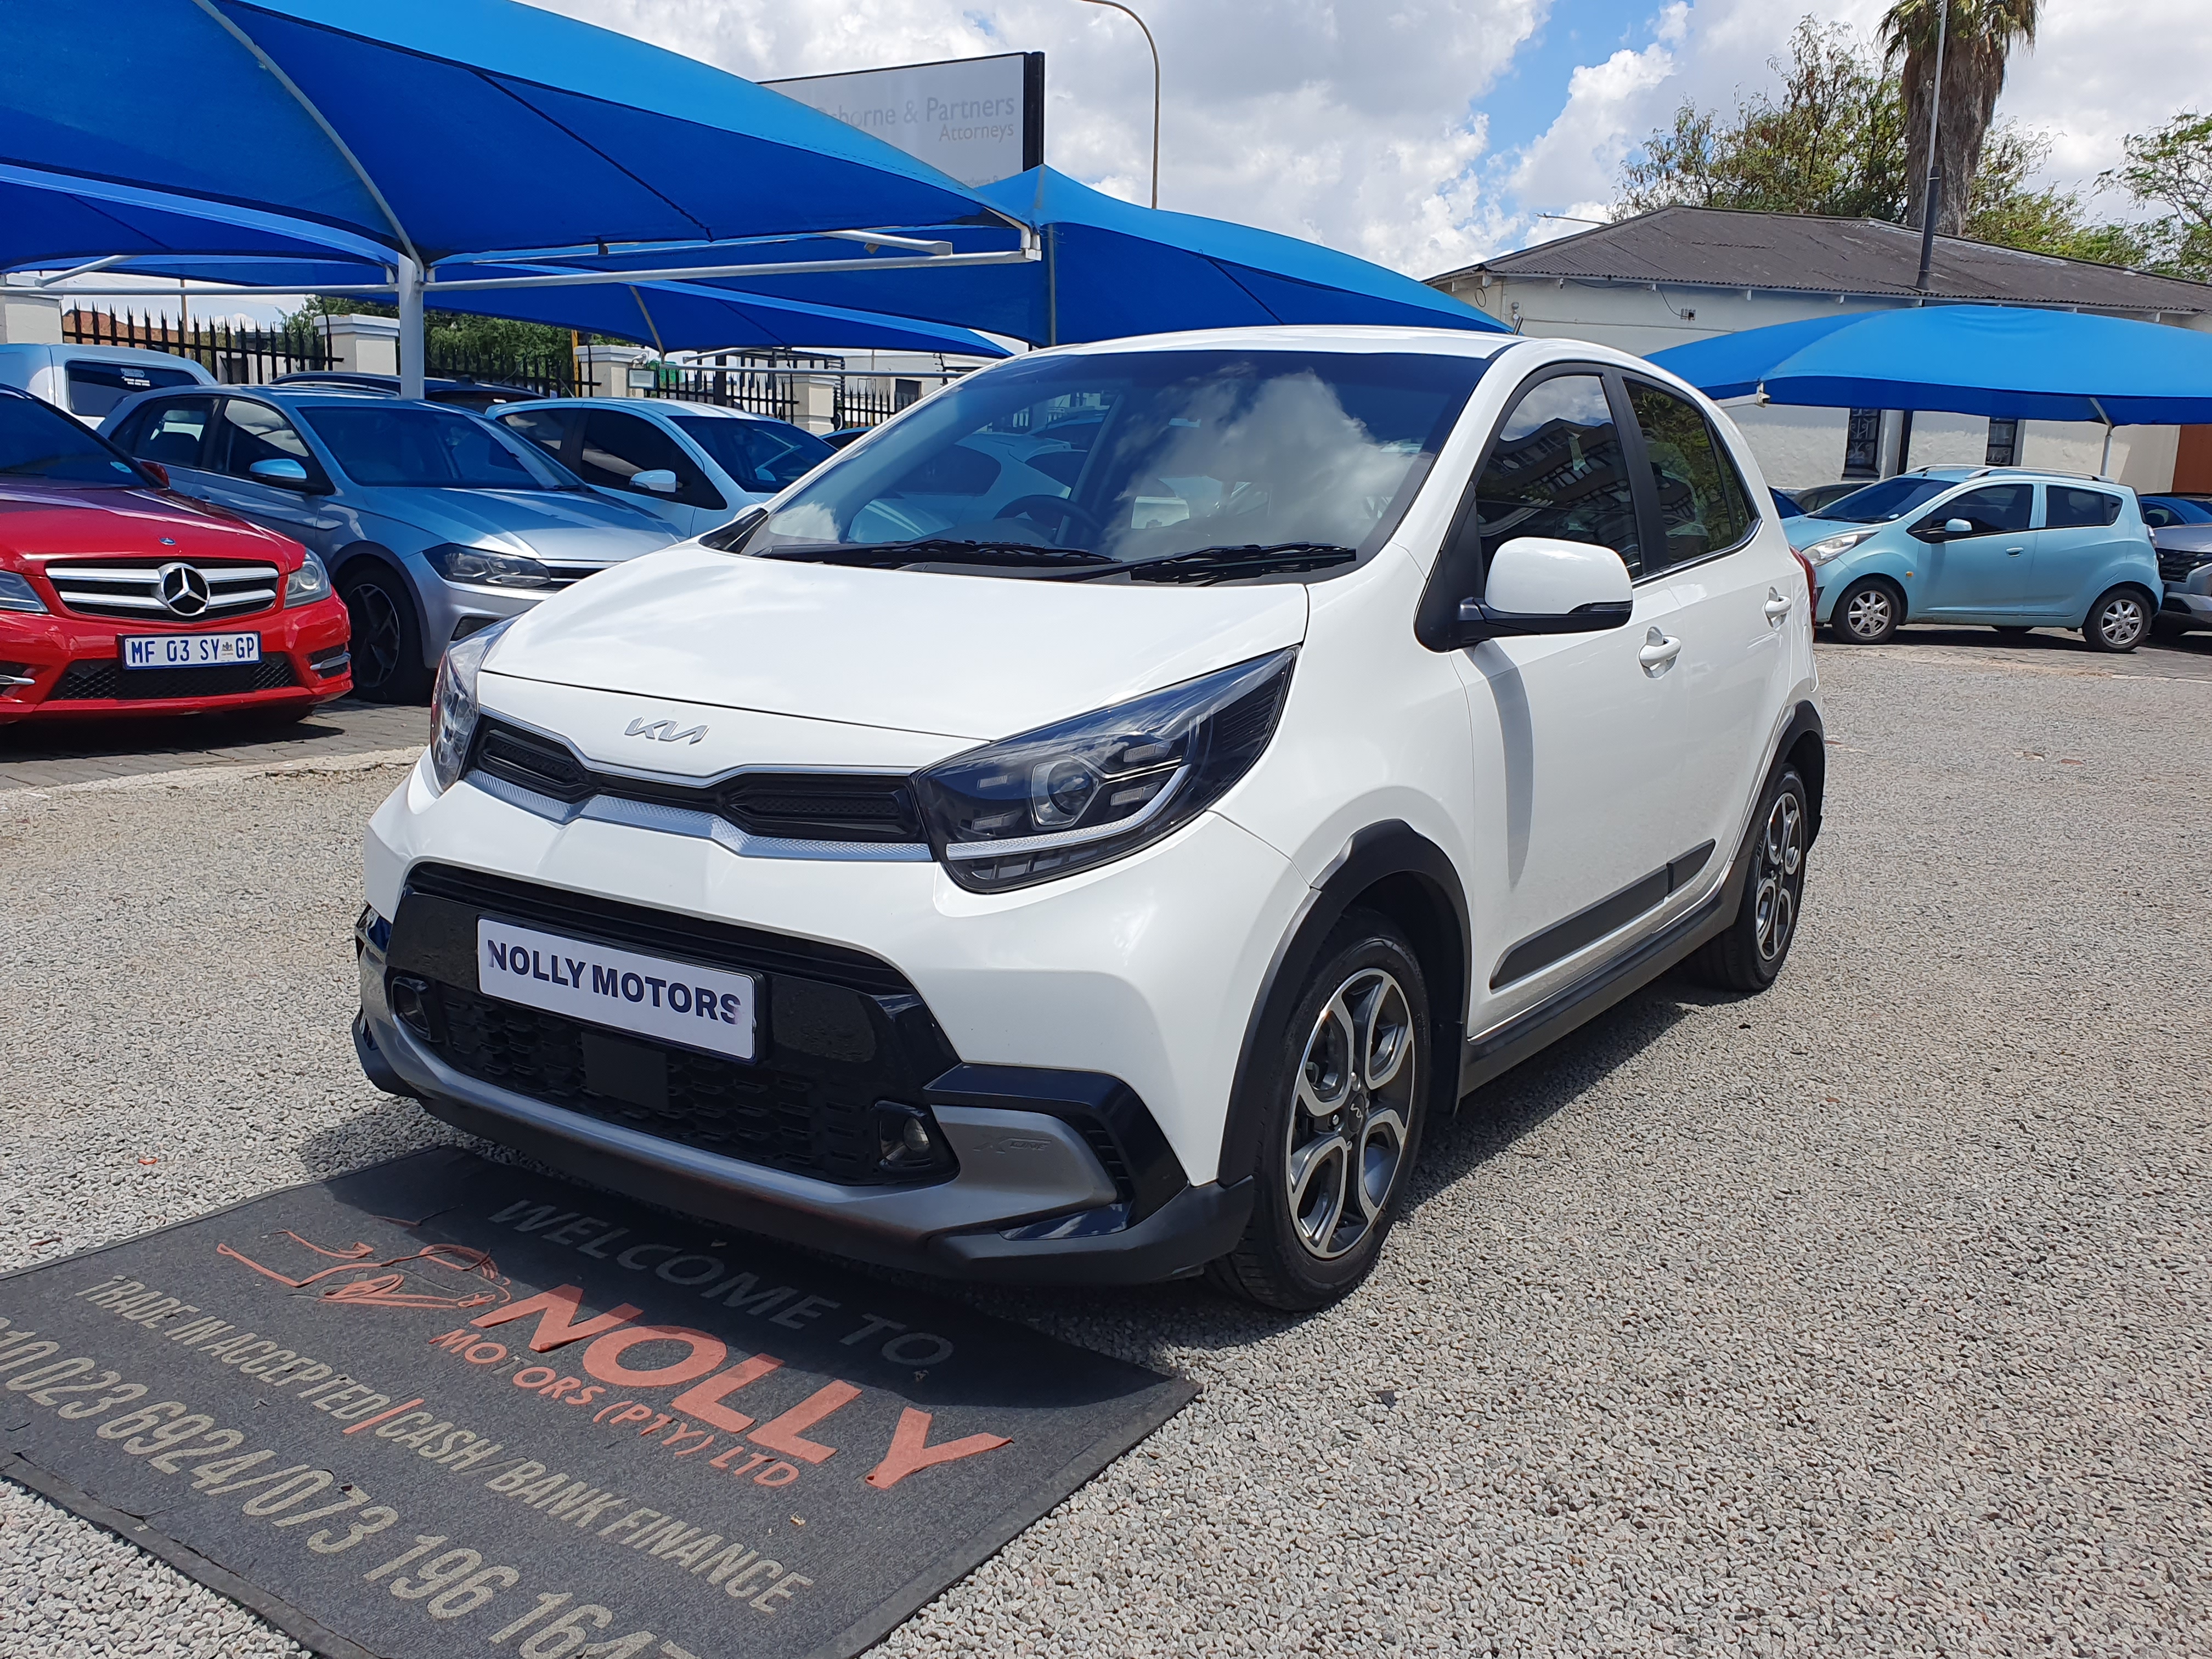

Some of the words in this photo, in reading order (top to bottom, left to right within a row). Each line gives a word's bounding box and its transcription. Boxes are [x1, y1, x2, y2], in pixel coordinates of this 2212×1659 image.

[816, 105, 896, 127] borne
[904, 100, 918, 123] &
[926, 96, 1015, 122] Partners
[938, 123, 1014, 144] Attorneys
[131, 641, 155, 663] MF
[167, 640, 190, 662] 03
[200, 638, 219, 661] SY
[235, 637, 255, 659] GP
[624, 716, 709, 745] KIA
[487, 940, 586, 989] NOLLY
[592, 965, 742, 1025] MOTORS
[487, 1199, 841, 1330] WELCOME
[839, 1313, 953, 1365] TO
[75, 1274, 201, 1329] TRADE
[164, 1316, 236, 1346] IN
[596, 1507, 815, 1615] FINANCE
[428, 1329, 606, 1406] MOTORS
[592, 1400, 715, 1457] (PTY)
[708, 1445, 799, 1487] LTD
[470, 1283, 1013, 1489] NOLLY
[5, 1357, 149, 1420] 023
[96, 1401, 399, 1554] 6924/073
[363, 1534, 520, 1620] 196
[488, 1592, 702, 1658] 164
